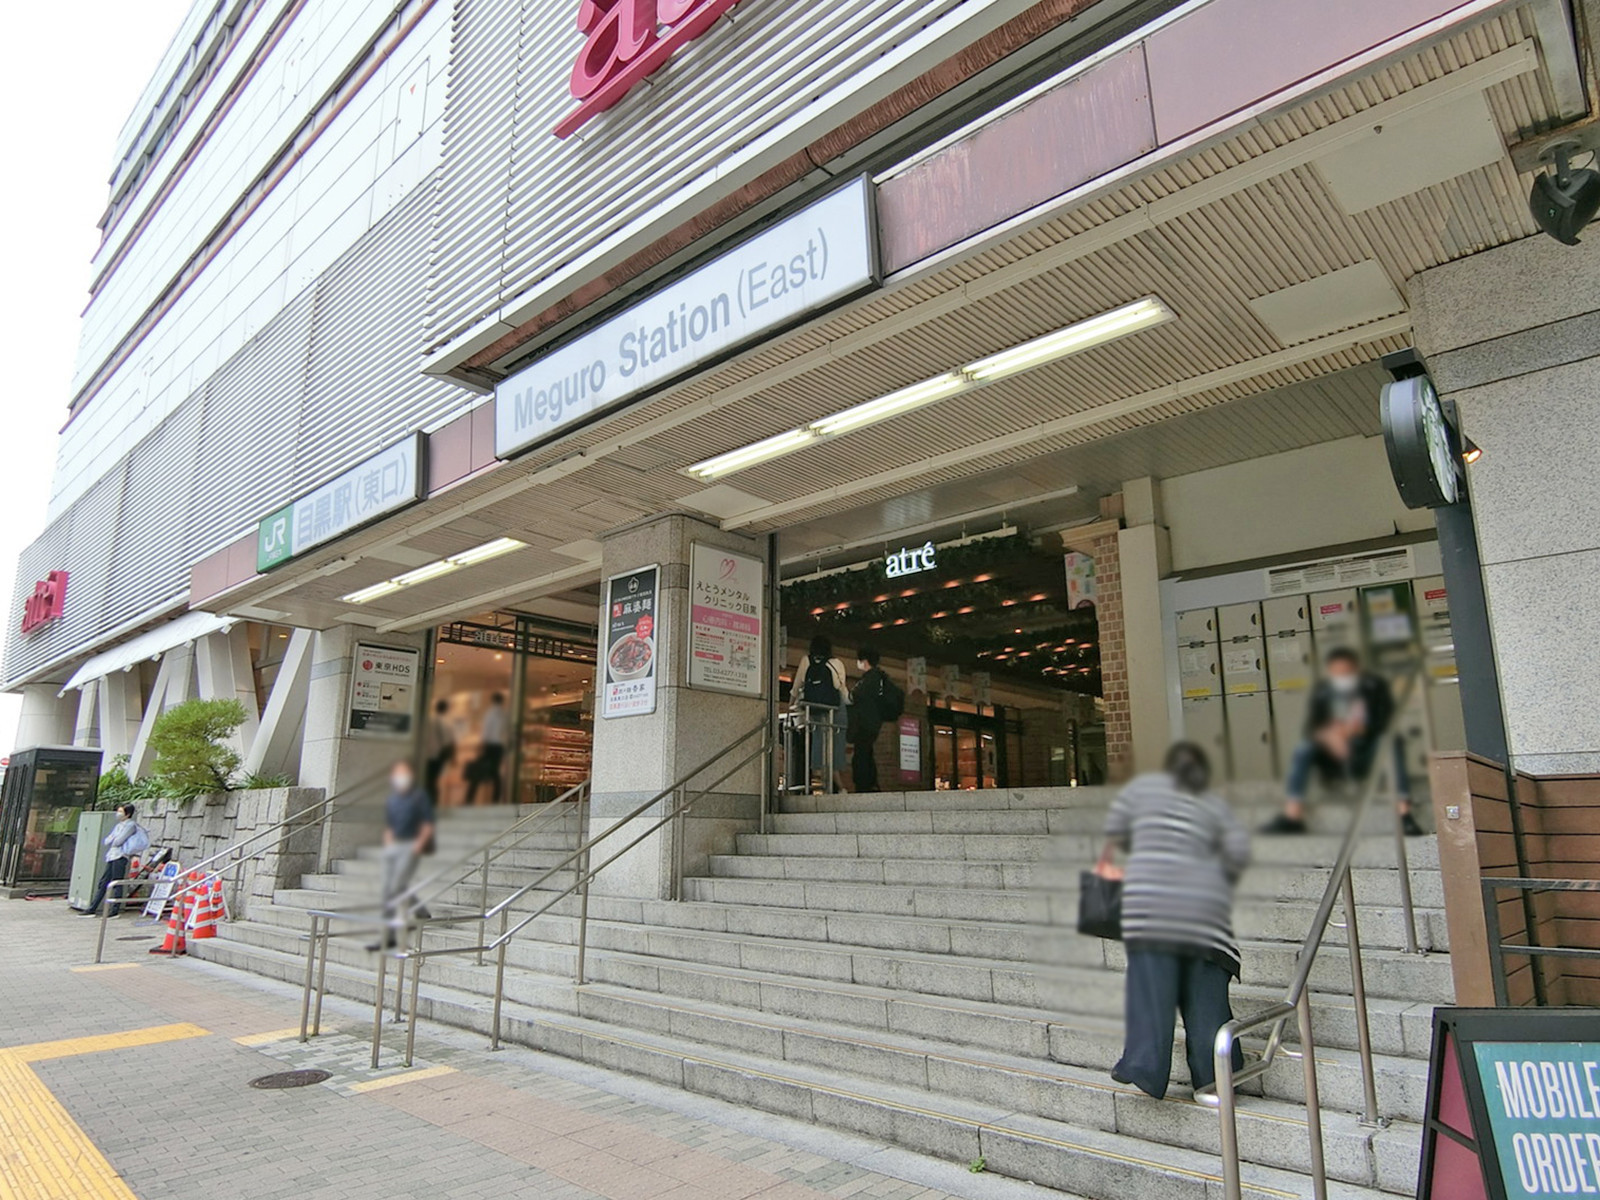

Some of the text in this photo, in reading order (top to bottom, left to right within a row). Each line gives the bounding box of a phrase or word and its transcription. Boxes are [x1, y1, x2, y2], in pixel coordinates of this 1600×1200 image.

[514, 227, 829, 432] Meguro Station (East)
[297, 452, 407, 548] 目黒駅(東口)
[264, 517, 286, 552] JR
[886, 541, 936, 577] atré
[696, 581, 750, 601] えとうメンタル
[704, 595, 757, 615] クリニック目黒
[375, 661, 410, 673] 東京HDS
[1495, 1061, 1600, 1119] MOBILE
